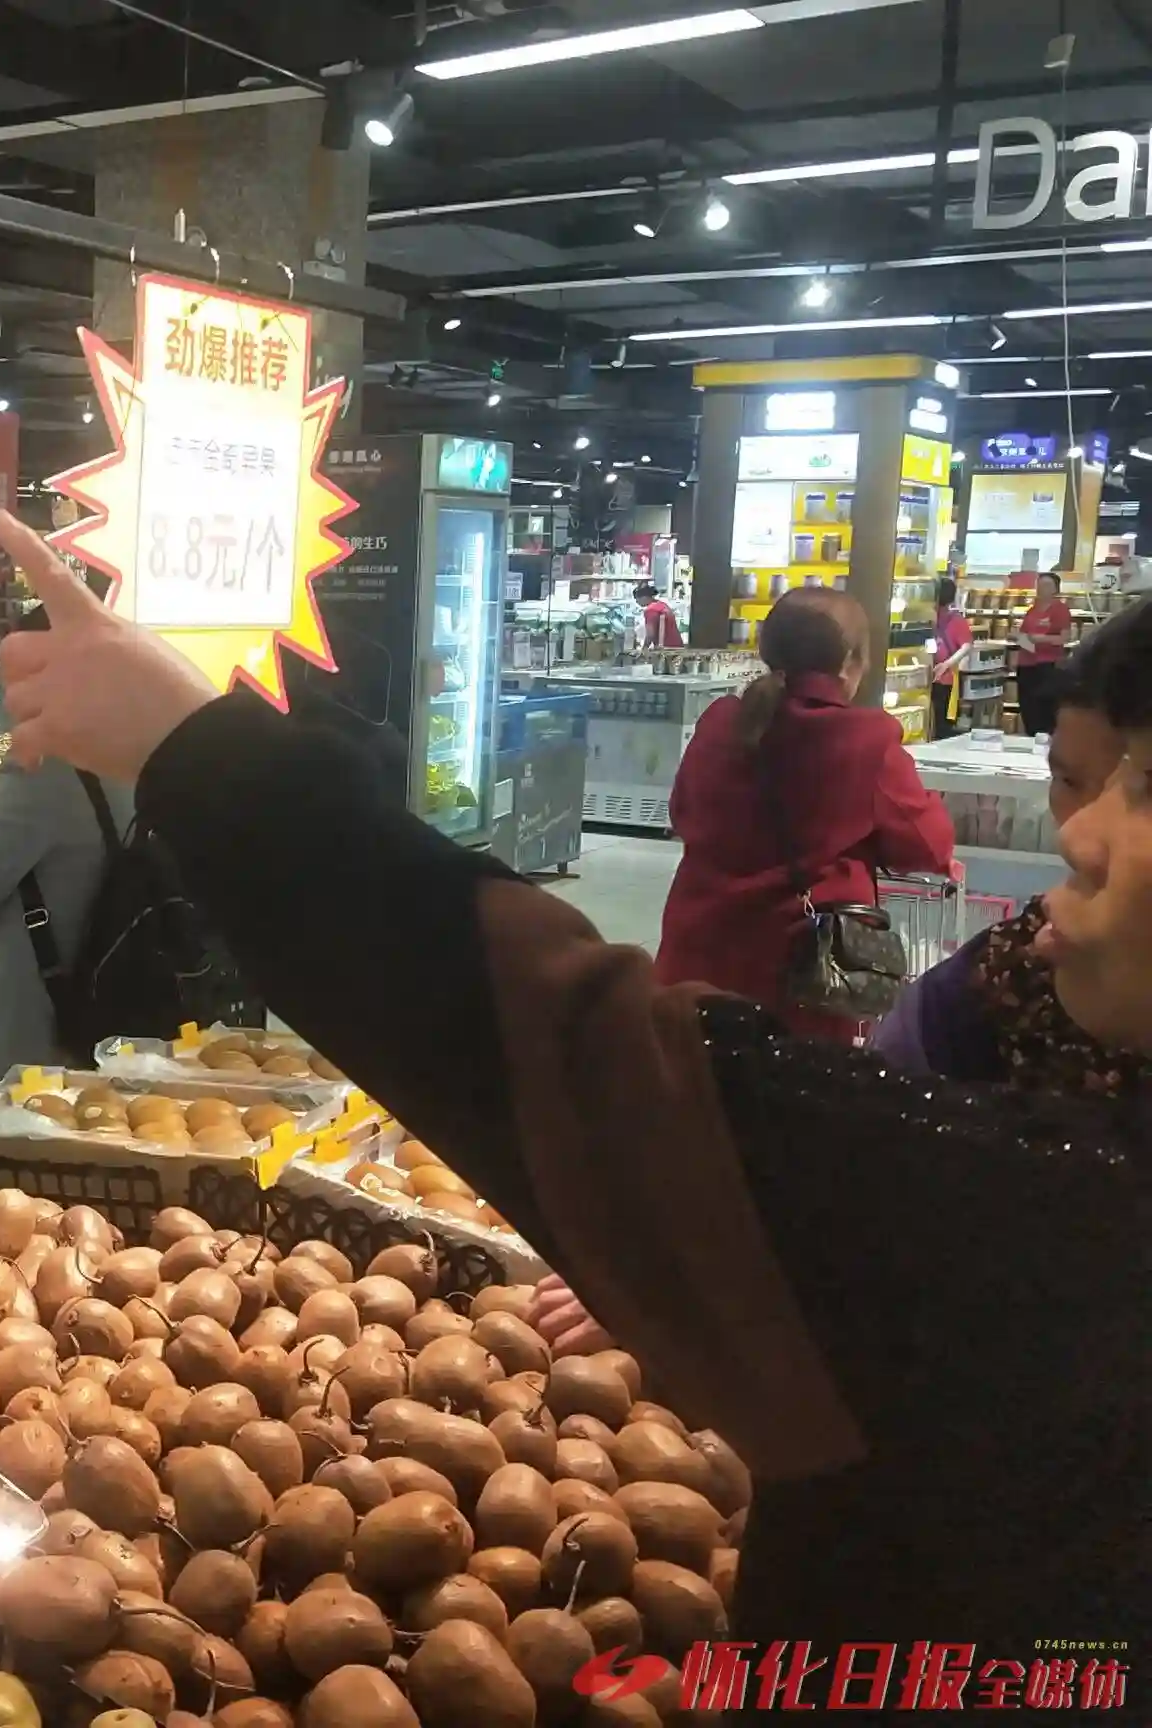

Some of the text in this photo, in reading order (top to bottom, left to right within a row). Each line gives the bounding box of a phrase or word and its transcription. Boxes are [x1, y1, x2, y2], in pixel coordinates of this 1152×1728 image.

[973, 116, 1152, 229] Da
[164, 317, 289, 392] 劲爆推荐
